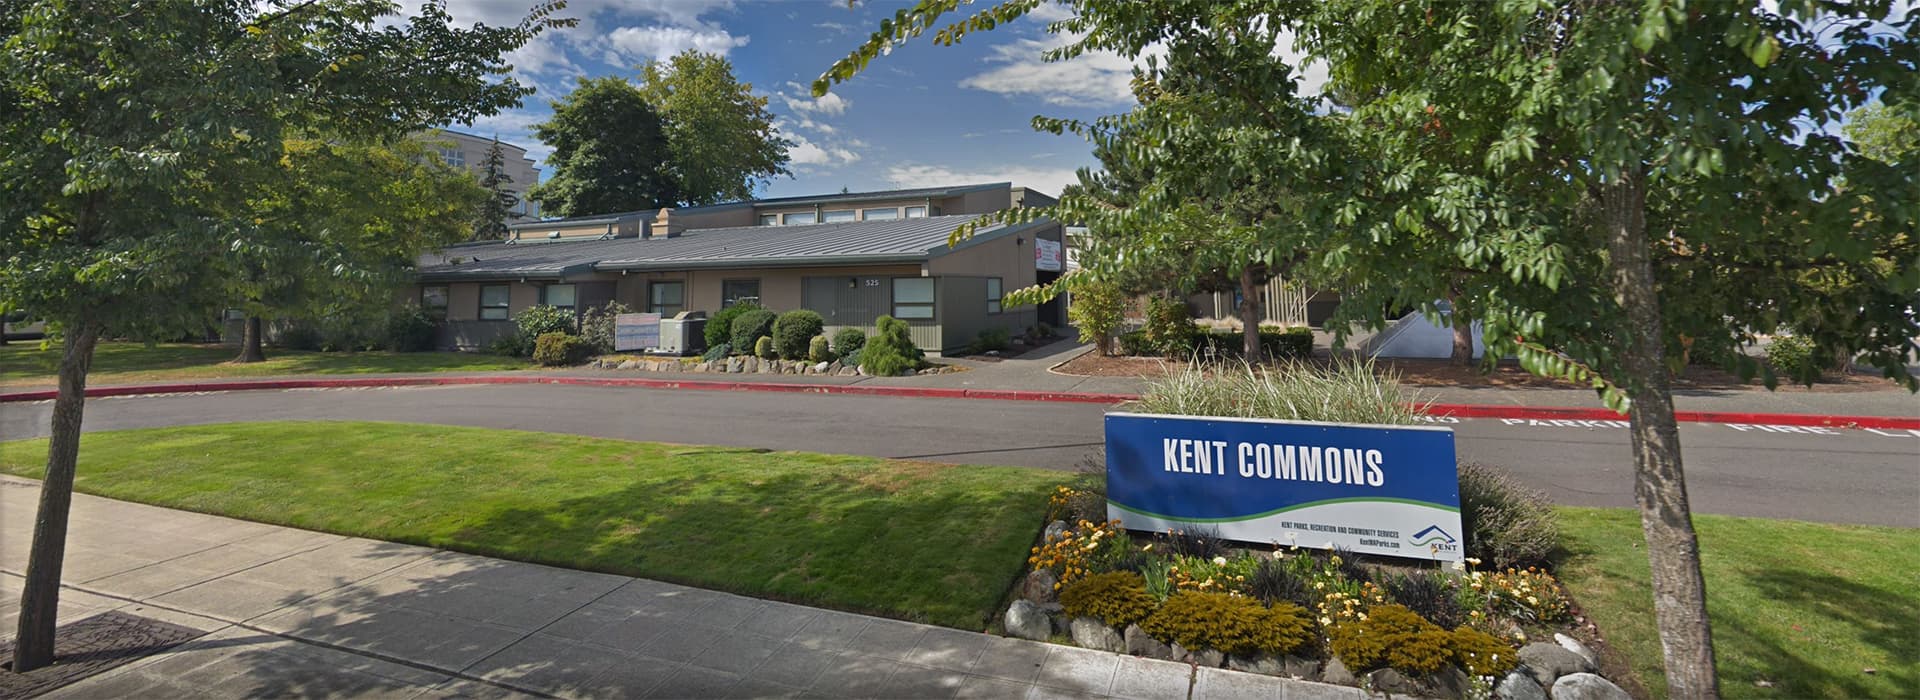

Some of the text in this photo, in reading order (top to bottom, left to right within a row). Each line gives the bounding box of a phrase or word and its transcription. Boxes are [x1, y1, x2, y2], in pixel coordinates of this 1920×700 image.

[865, 279, 879, 287] 525
[1725, 423, 1841, 435] FIRE
[1163, 438, 1384, 487] KENT COMMONS
[1281, 521, 1293, 529] KENT
[1310, 523, 1336, 533] RECREATION
[1338, 526, 1347, 534] AND
[1348, 527, 1376, 537] COMMUNITY
[1377, 529, 1399, 539] SERVICES
